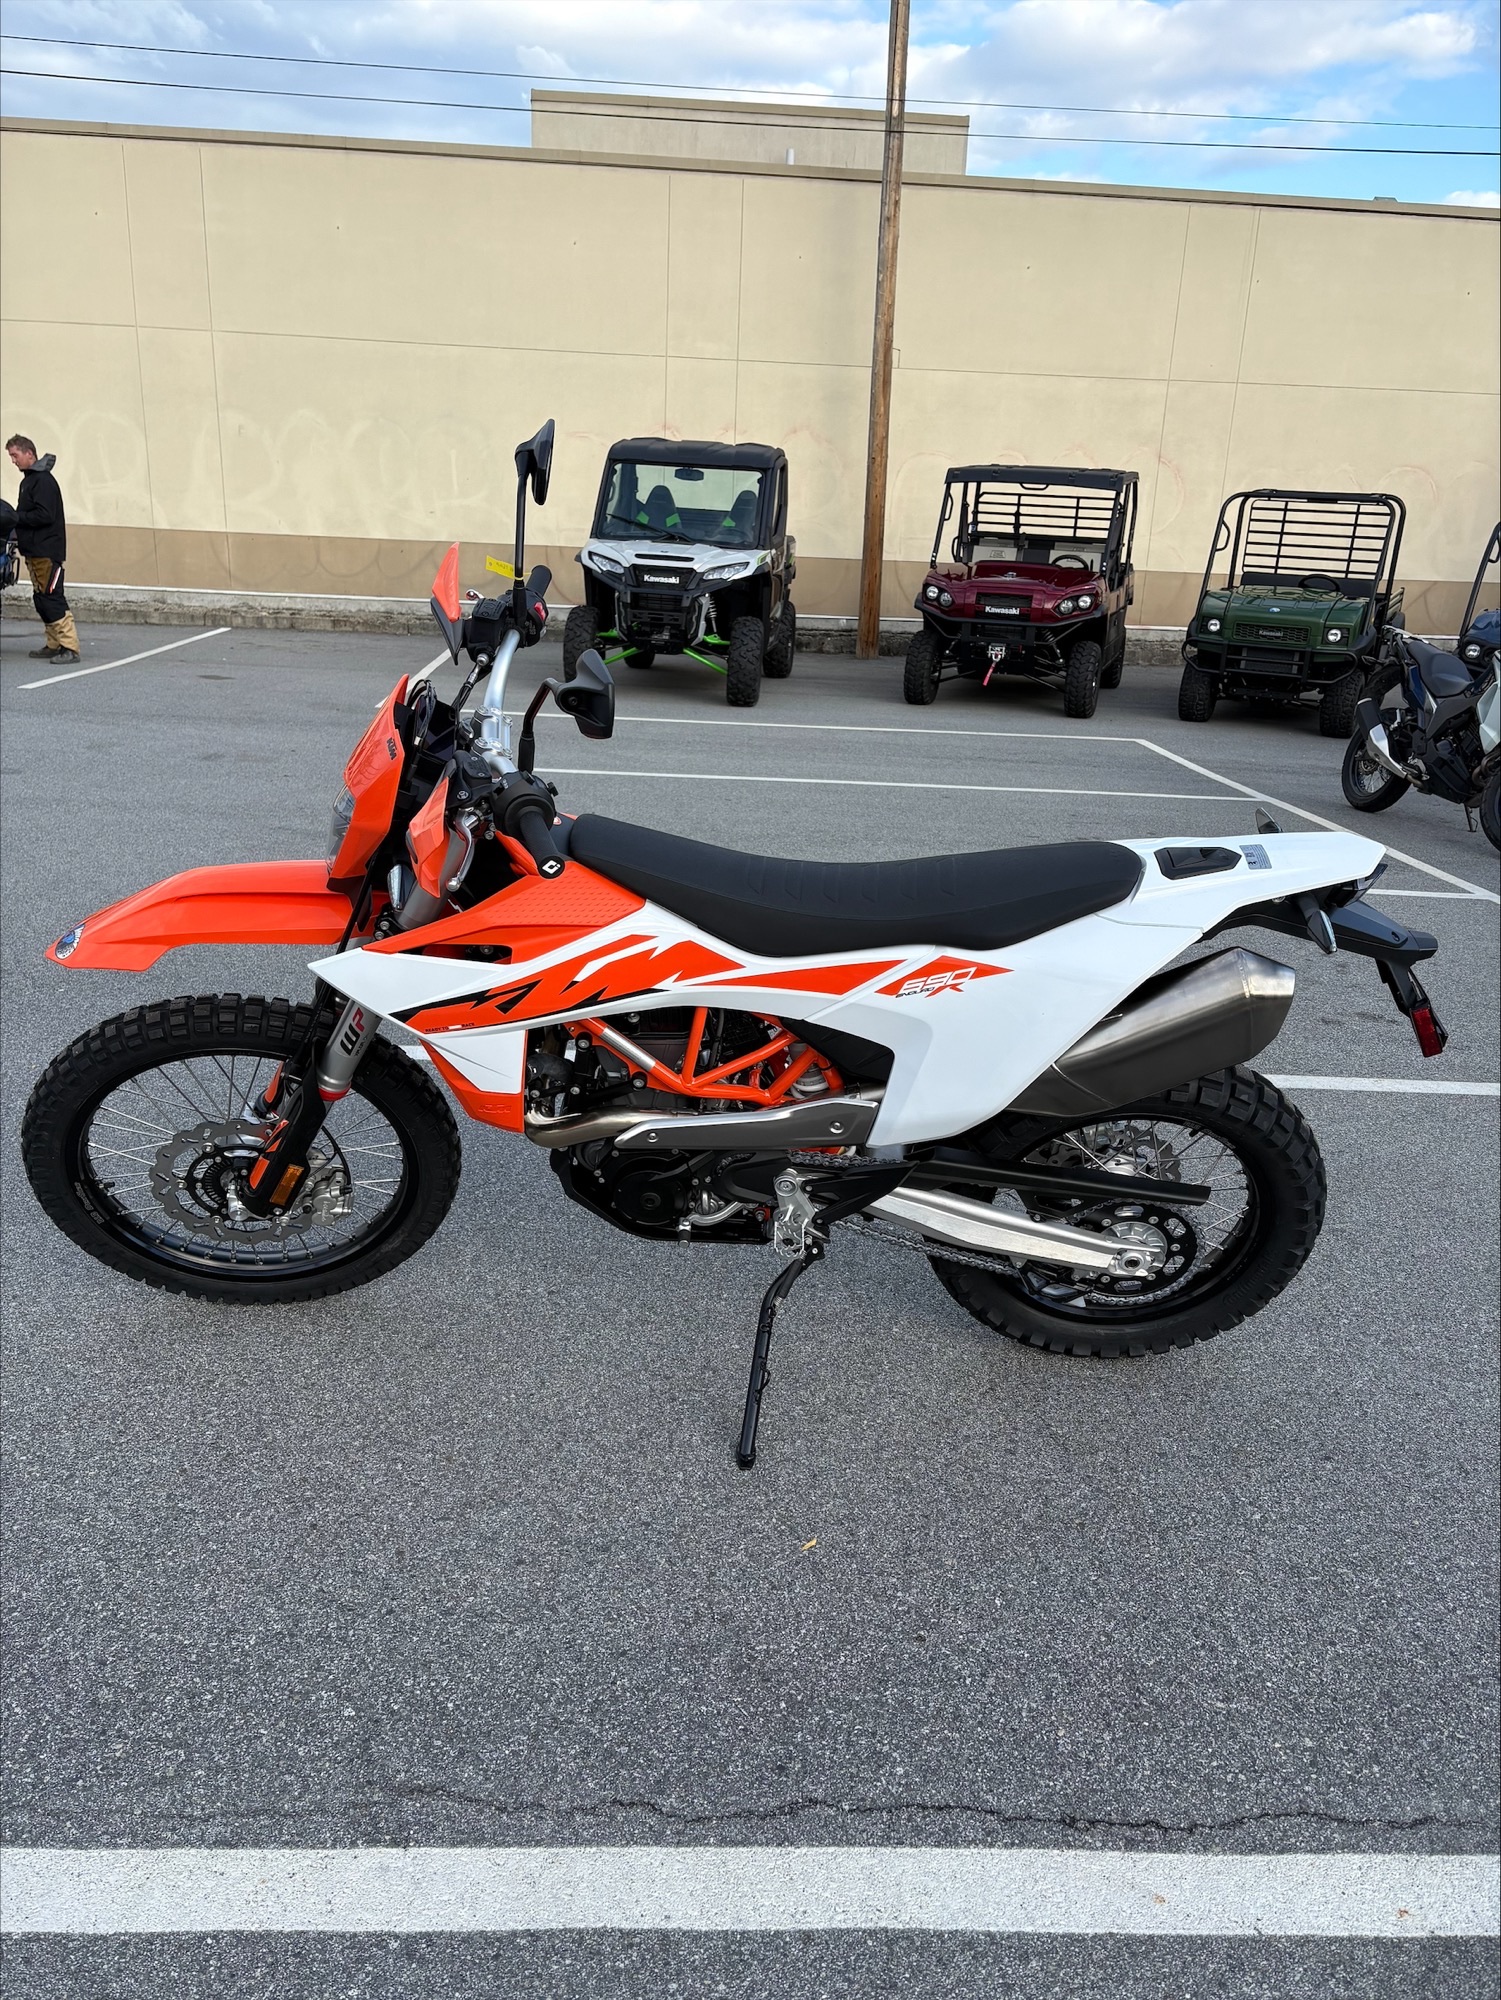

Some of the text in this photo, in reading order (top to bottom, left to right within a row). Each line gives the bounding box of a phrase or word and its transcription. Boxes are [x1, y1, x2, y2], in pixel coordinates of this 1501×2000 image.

[643, 574, 680, 584] Kawasaki
[984, 605, 1020, 615] Kawasaki
[897, 966, 978, 994] 690
